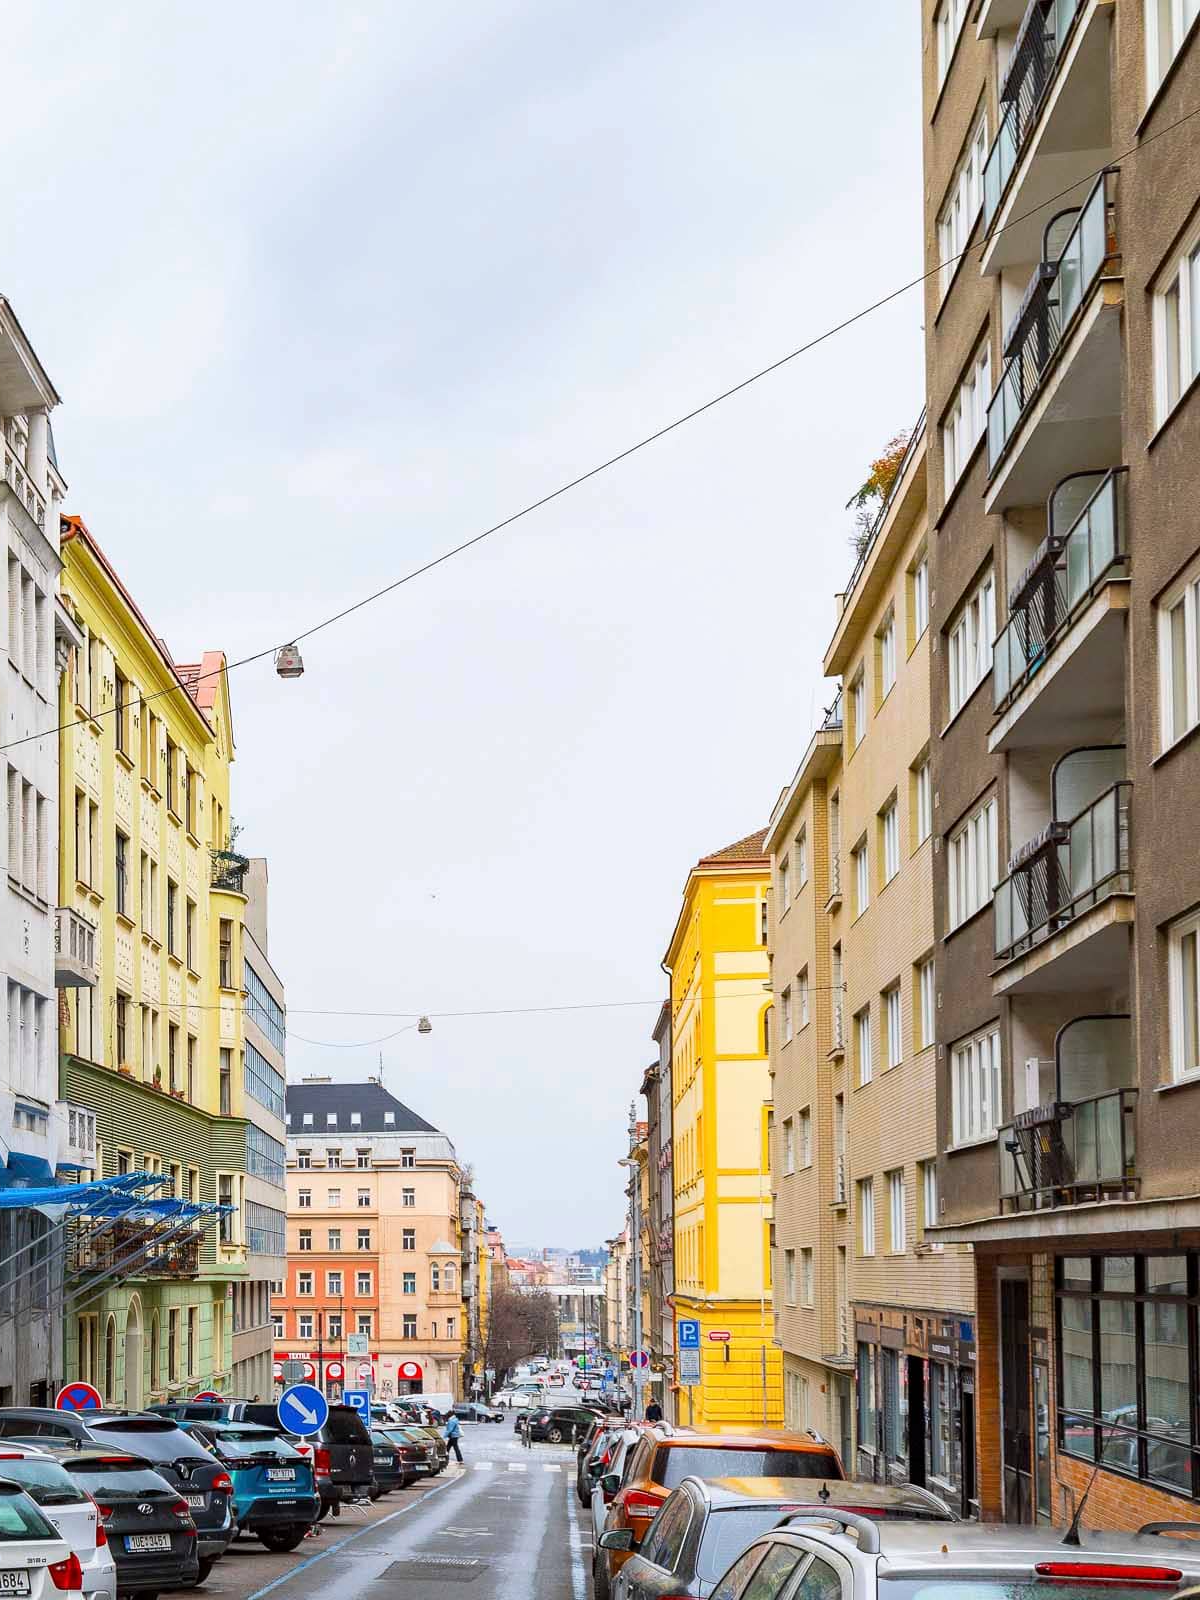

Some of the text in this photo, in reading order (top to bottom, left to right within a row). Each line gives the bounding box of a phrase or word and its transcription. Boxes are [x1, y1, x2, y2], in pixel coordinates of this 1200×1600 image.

[683, 1323, 696, 1340] P
[288, 1352, 311, 1360] TEXTILE
[350, 1395, 365, 1408] P
